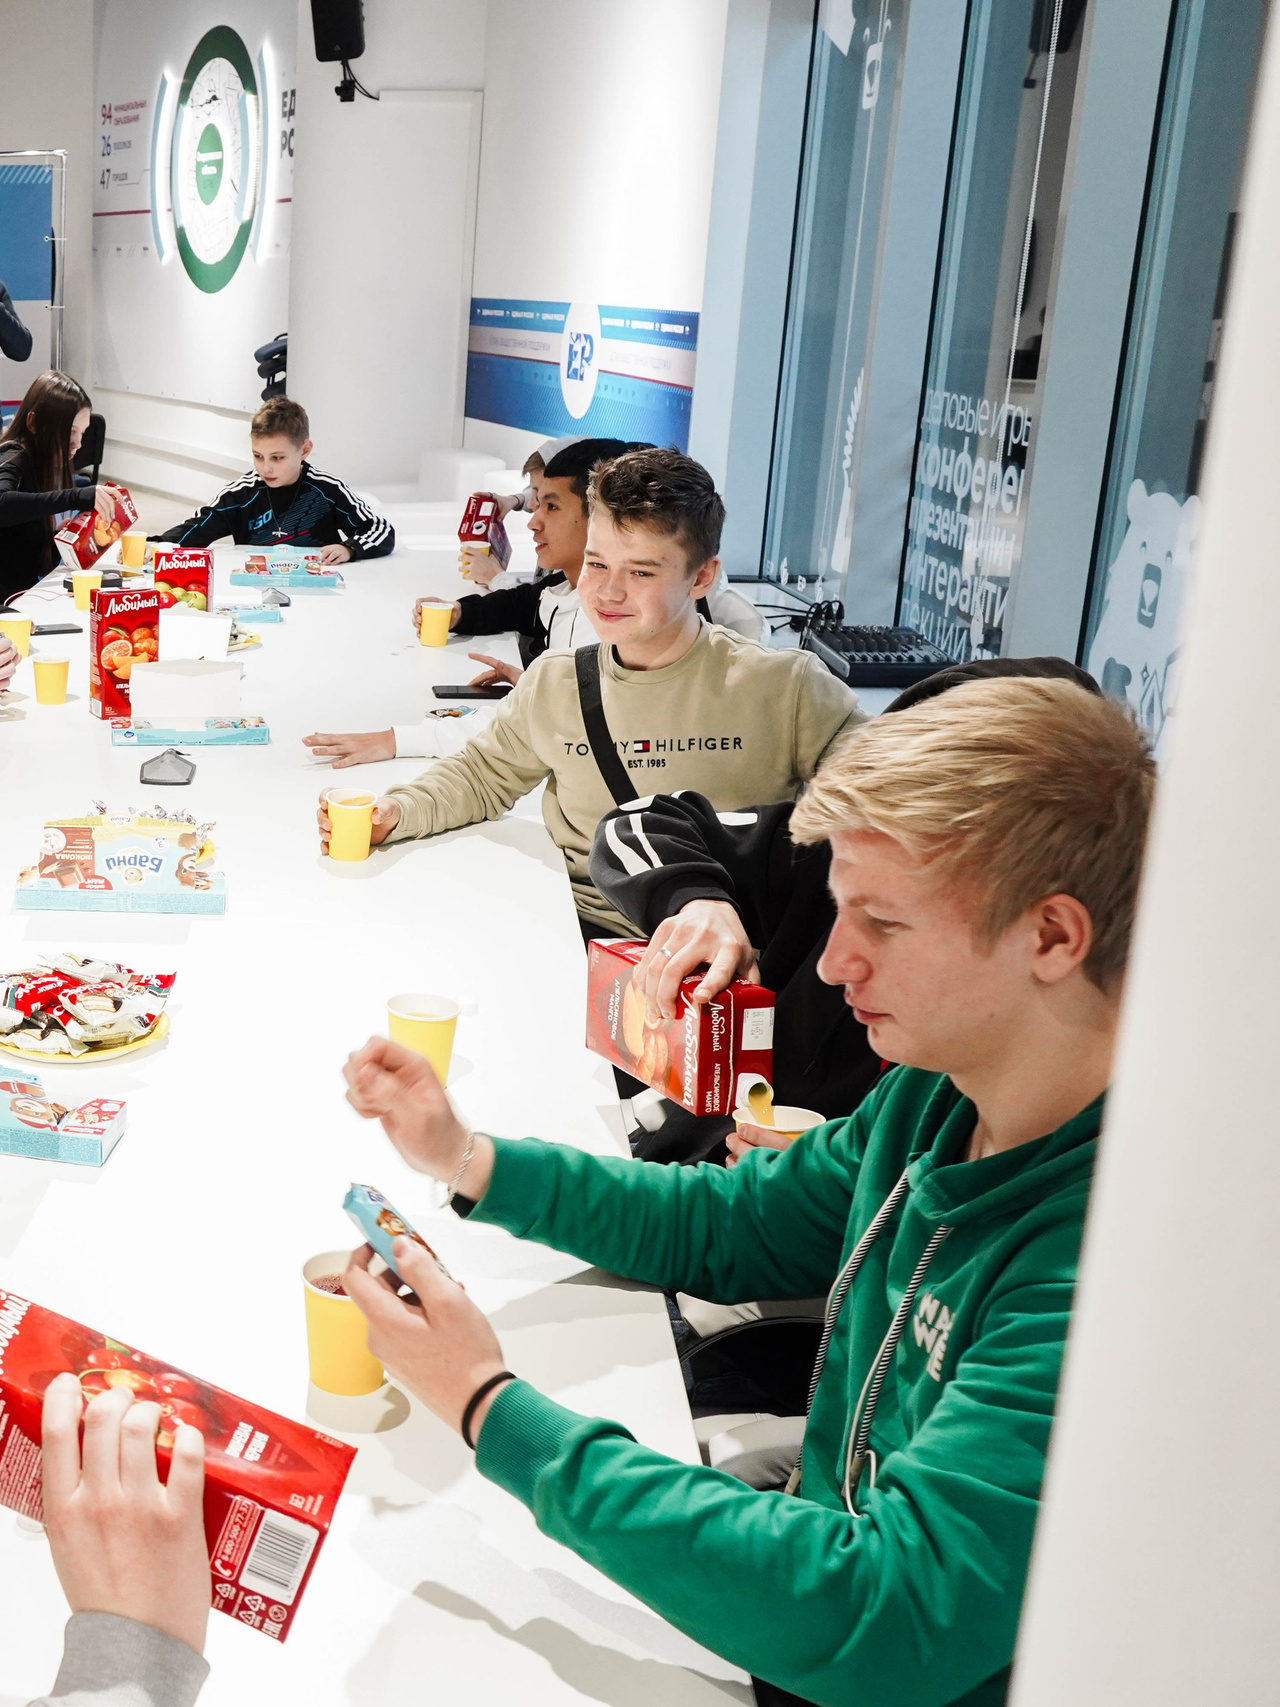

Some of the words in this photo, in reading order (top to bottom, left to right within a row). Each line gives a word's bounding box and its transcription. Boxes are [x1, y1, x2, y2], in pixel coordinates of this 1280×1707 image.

[101, 103, 112, 125] 94
[102, 135, 111, 156] 26
[100, 168, 111, 189] 47
[155, 554, 207, 573] Любимый
[104, 593, 159, 618] Любимый
[564, 741, 629, 756] TOY
[656, 736, 744, 752] HILFIGER
[628, 759, 644, 769] EST.
[647, 758, 666, 768] 1985
[105, 854, 163, 873] Барни
[141, 974, 163, 988] Pie
[608, 994, 616, 1021] МАНГО
[611, 979, 620, 1041] АПЕЛЬСИНОВОЕ
[709, 1000, 726, 1052] Любимый
[681, 990, 700, 1107] Любимый
[713, 1063, 721, 1113] АПЕЛЬСИНОВОЕ
